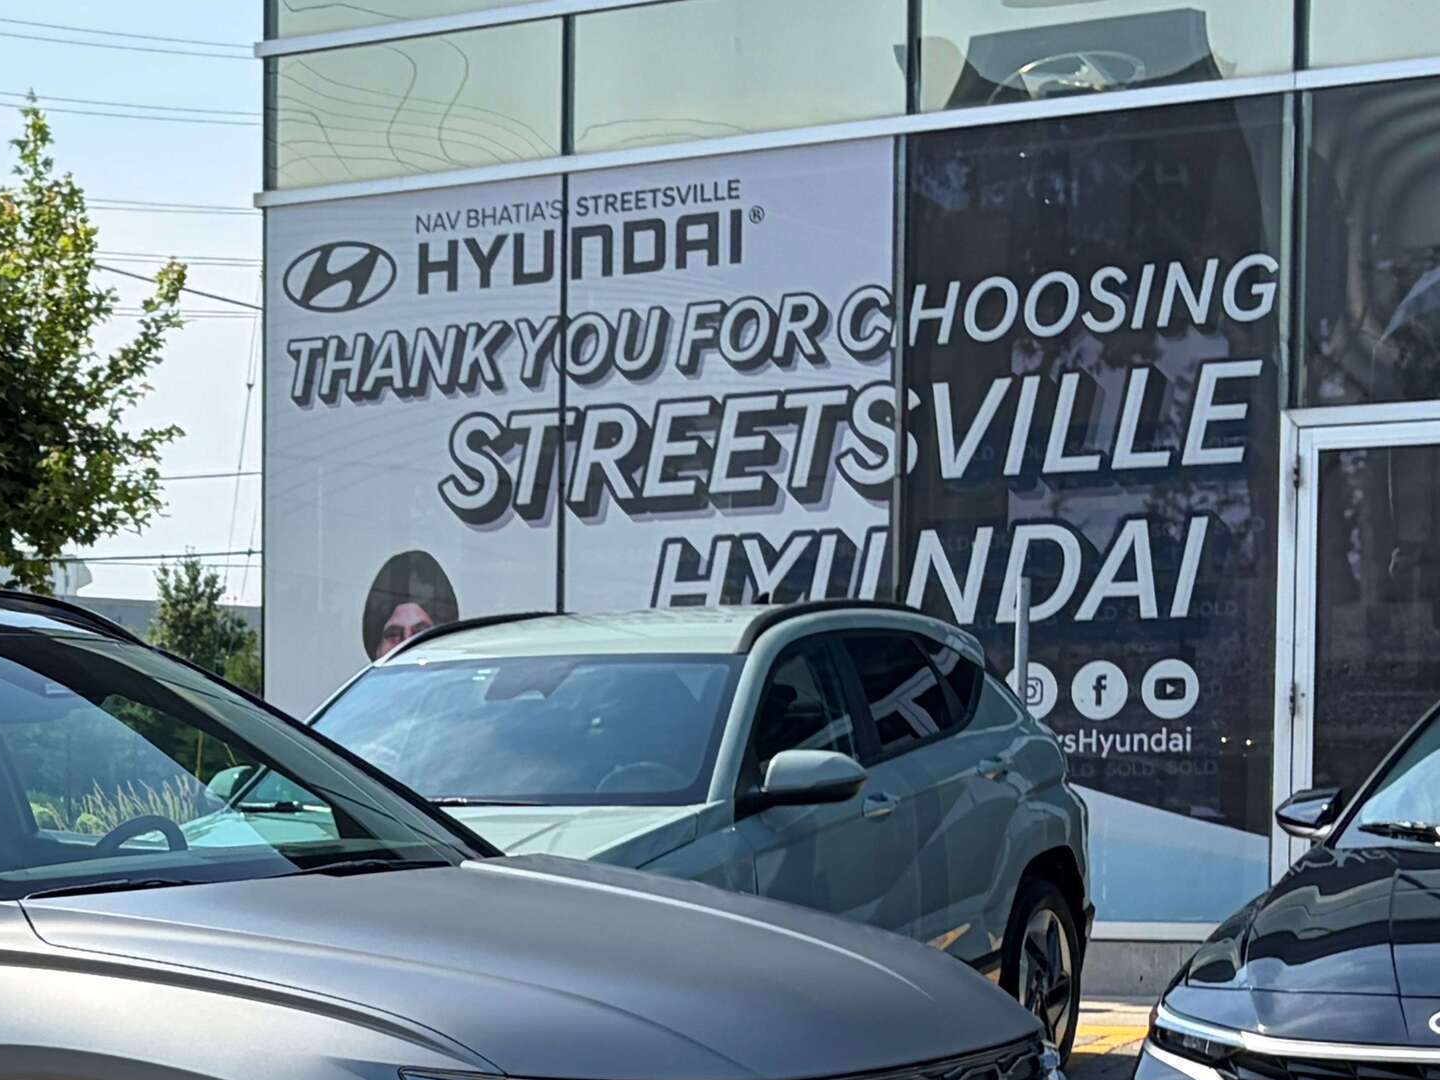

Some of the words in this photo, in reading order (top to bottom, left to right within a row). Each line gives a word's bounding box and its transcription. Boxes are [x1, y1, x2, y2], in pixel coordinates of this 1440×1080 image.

[415, 211, 461, 234] NAV
[466, 199, 568, 228] BHATIA'S
[576, 179, 741, 217] STREETSVILLE
[287, 320, 513, 406] THANK
[516, 305, 671, 389] YOU
[675, 292, 831, 380] FOR
[838, 254, 1279, 366] CHOOSING
[438, 359, 1263, 526] STREETSVILLE
[650, 511, 1209, 624] HYUNDAI
